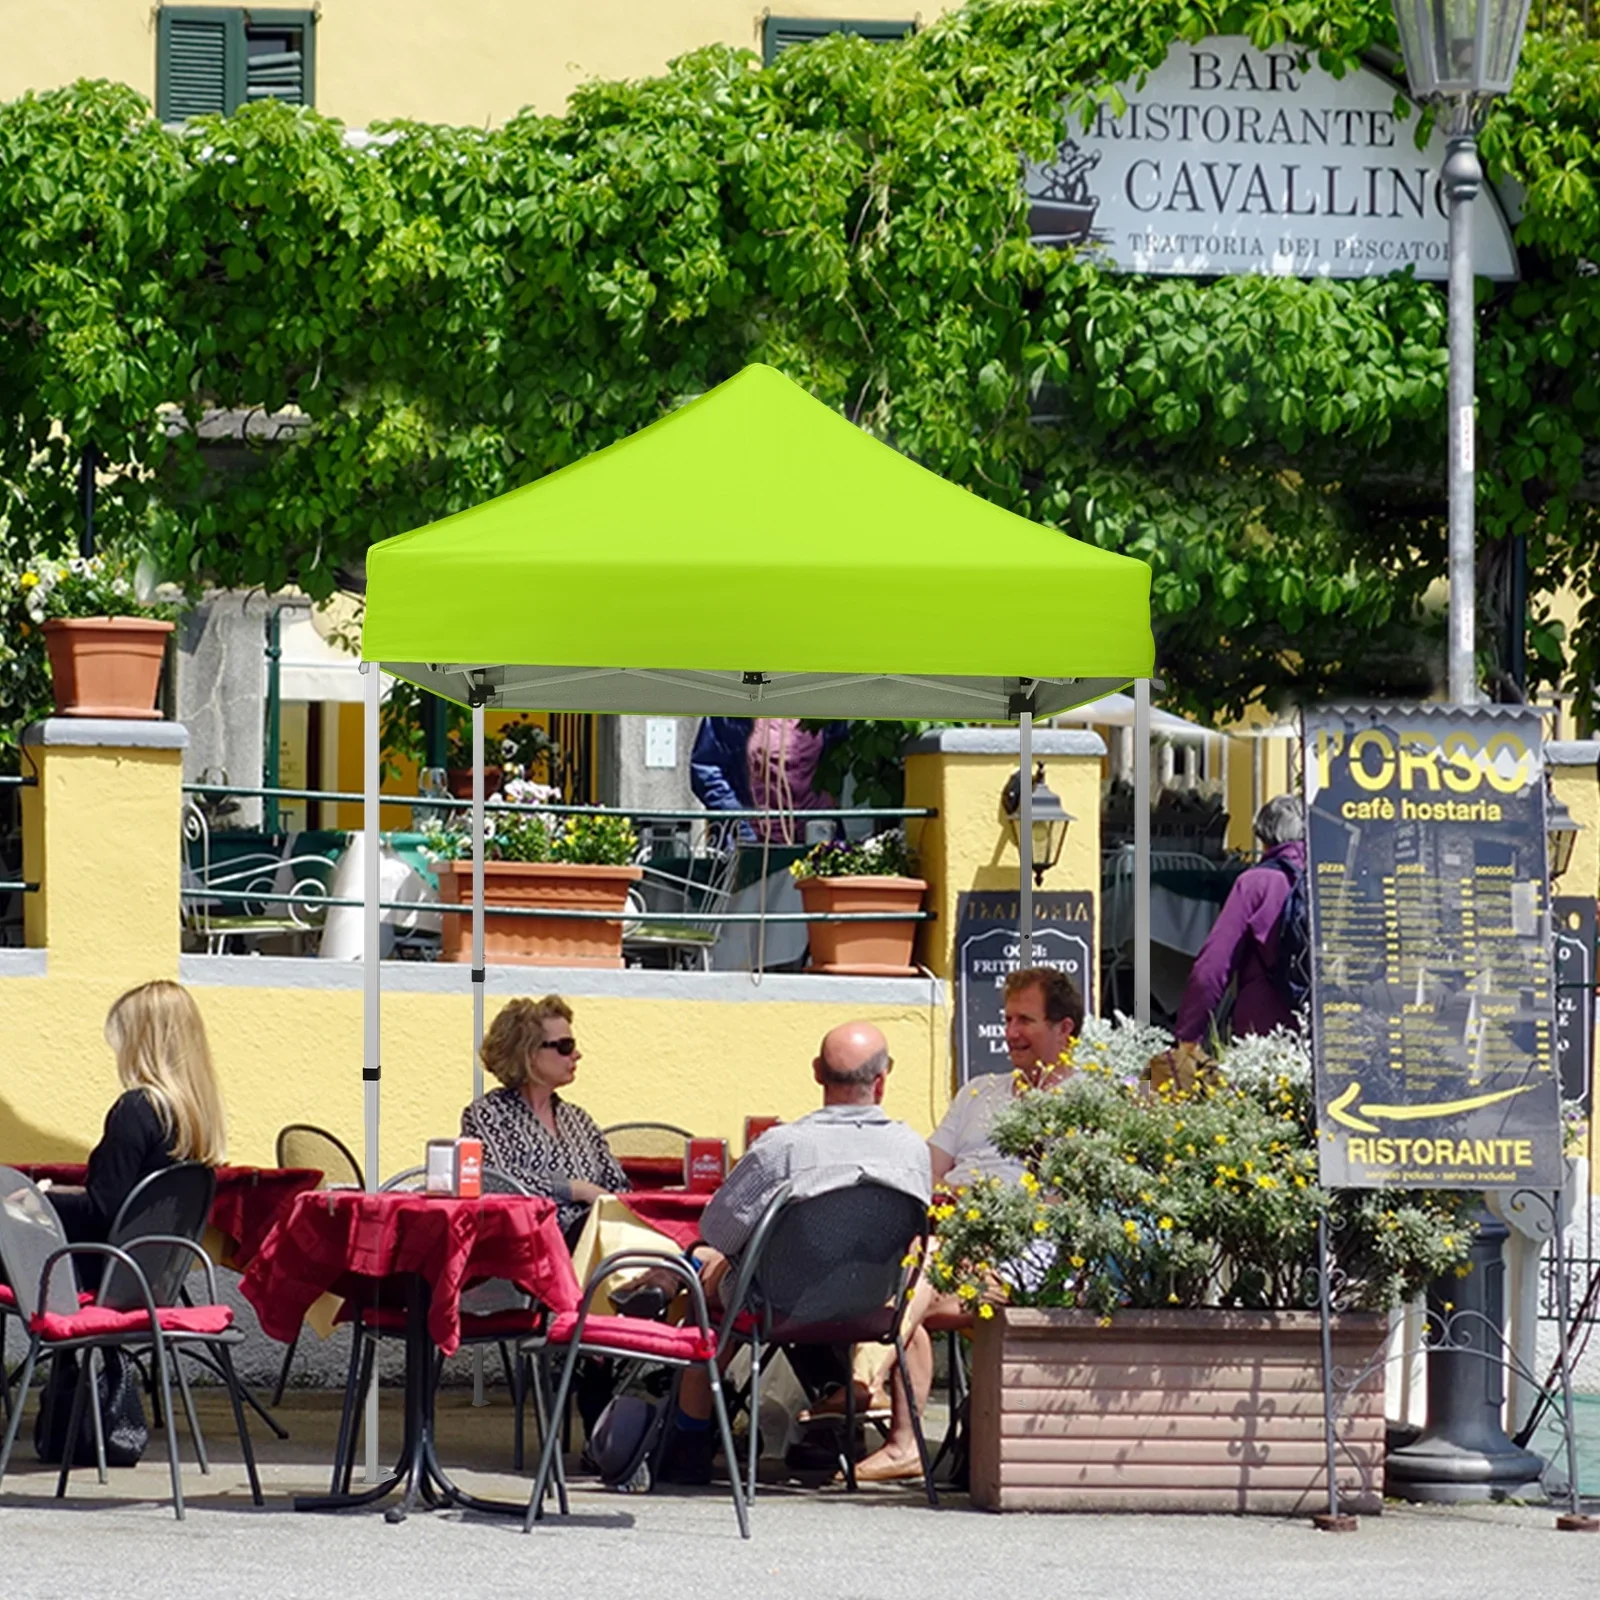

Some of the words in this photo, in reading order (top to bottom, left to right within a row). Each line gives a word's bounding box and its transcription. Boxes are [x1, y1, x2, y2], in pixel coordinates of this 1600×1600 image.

[1189, 51, 1300, 92] BAR
[1092, 102, 1396, 148] RISTORANTE
[1124, 158, 1450, 220] CAVALLIN
[1128, 232, 1264, 257] TRATTORIA
[1279, 236, 1321, 258] DEI
[1401, 799, 1502, 821] hostaria
[1347, 1137, 1533, 1166] RISTORANTE
